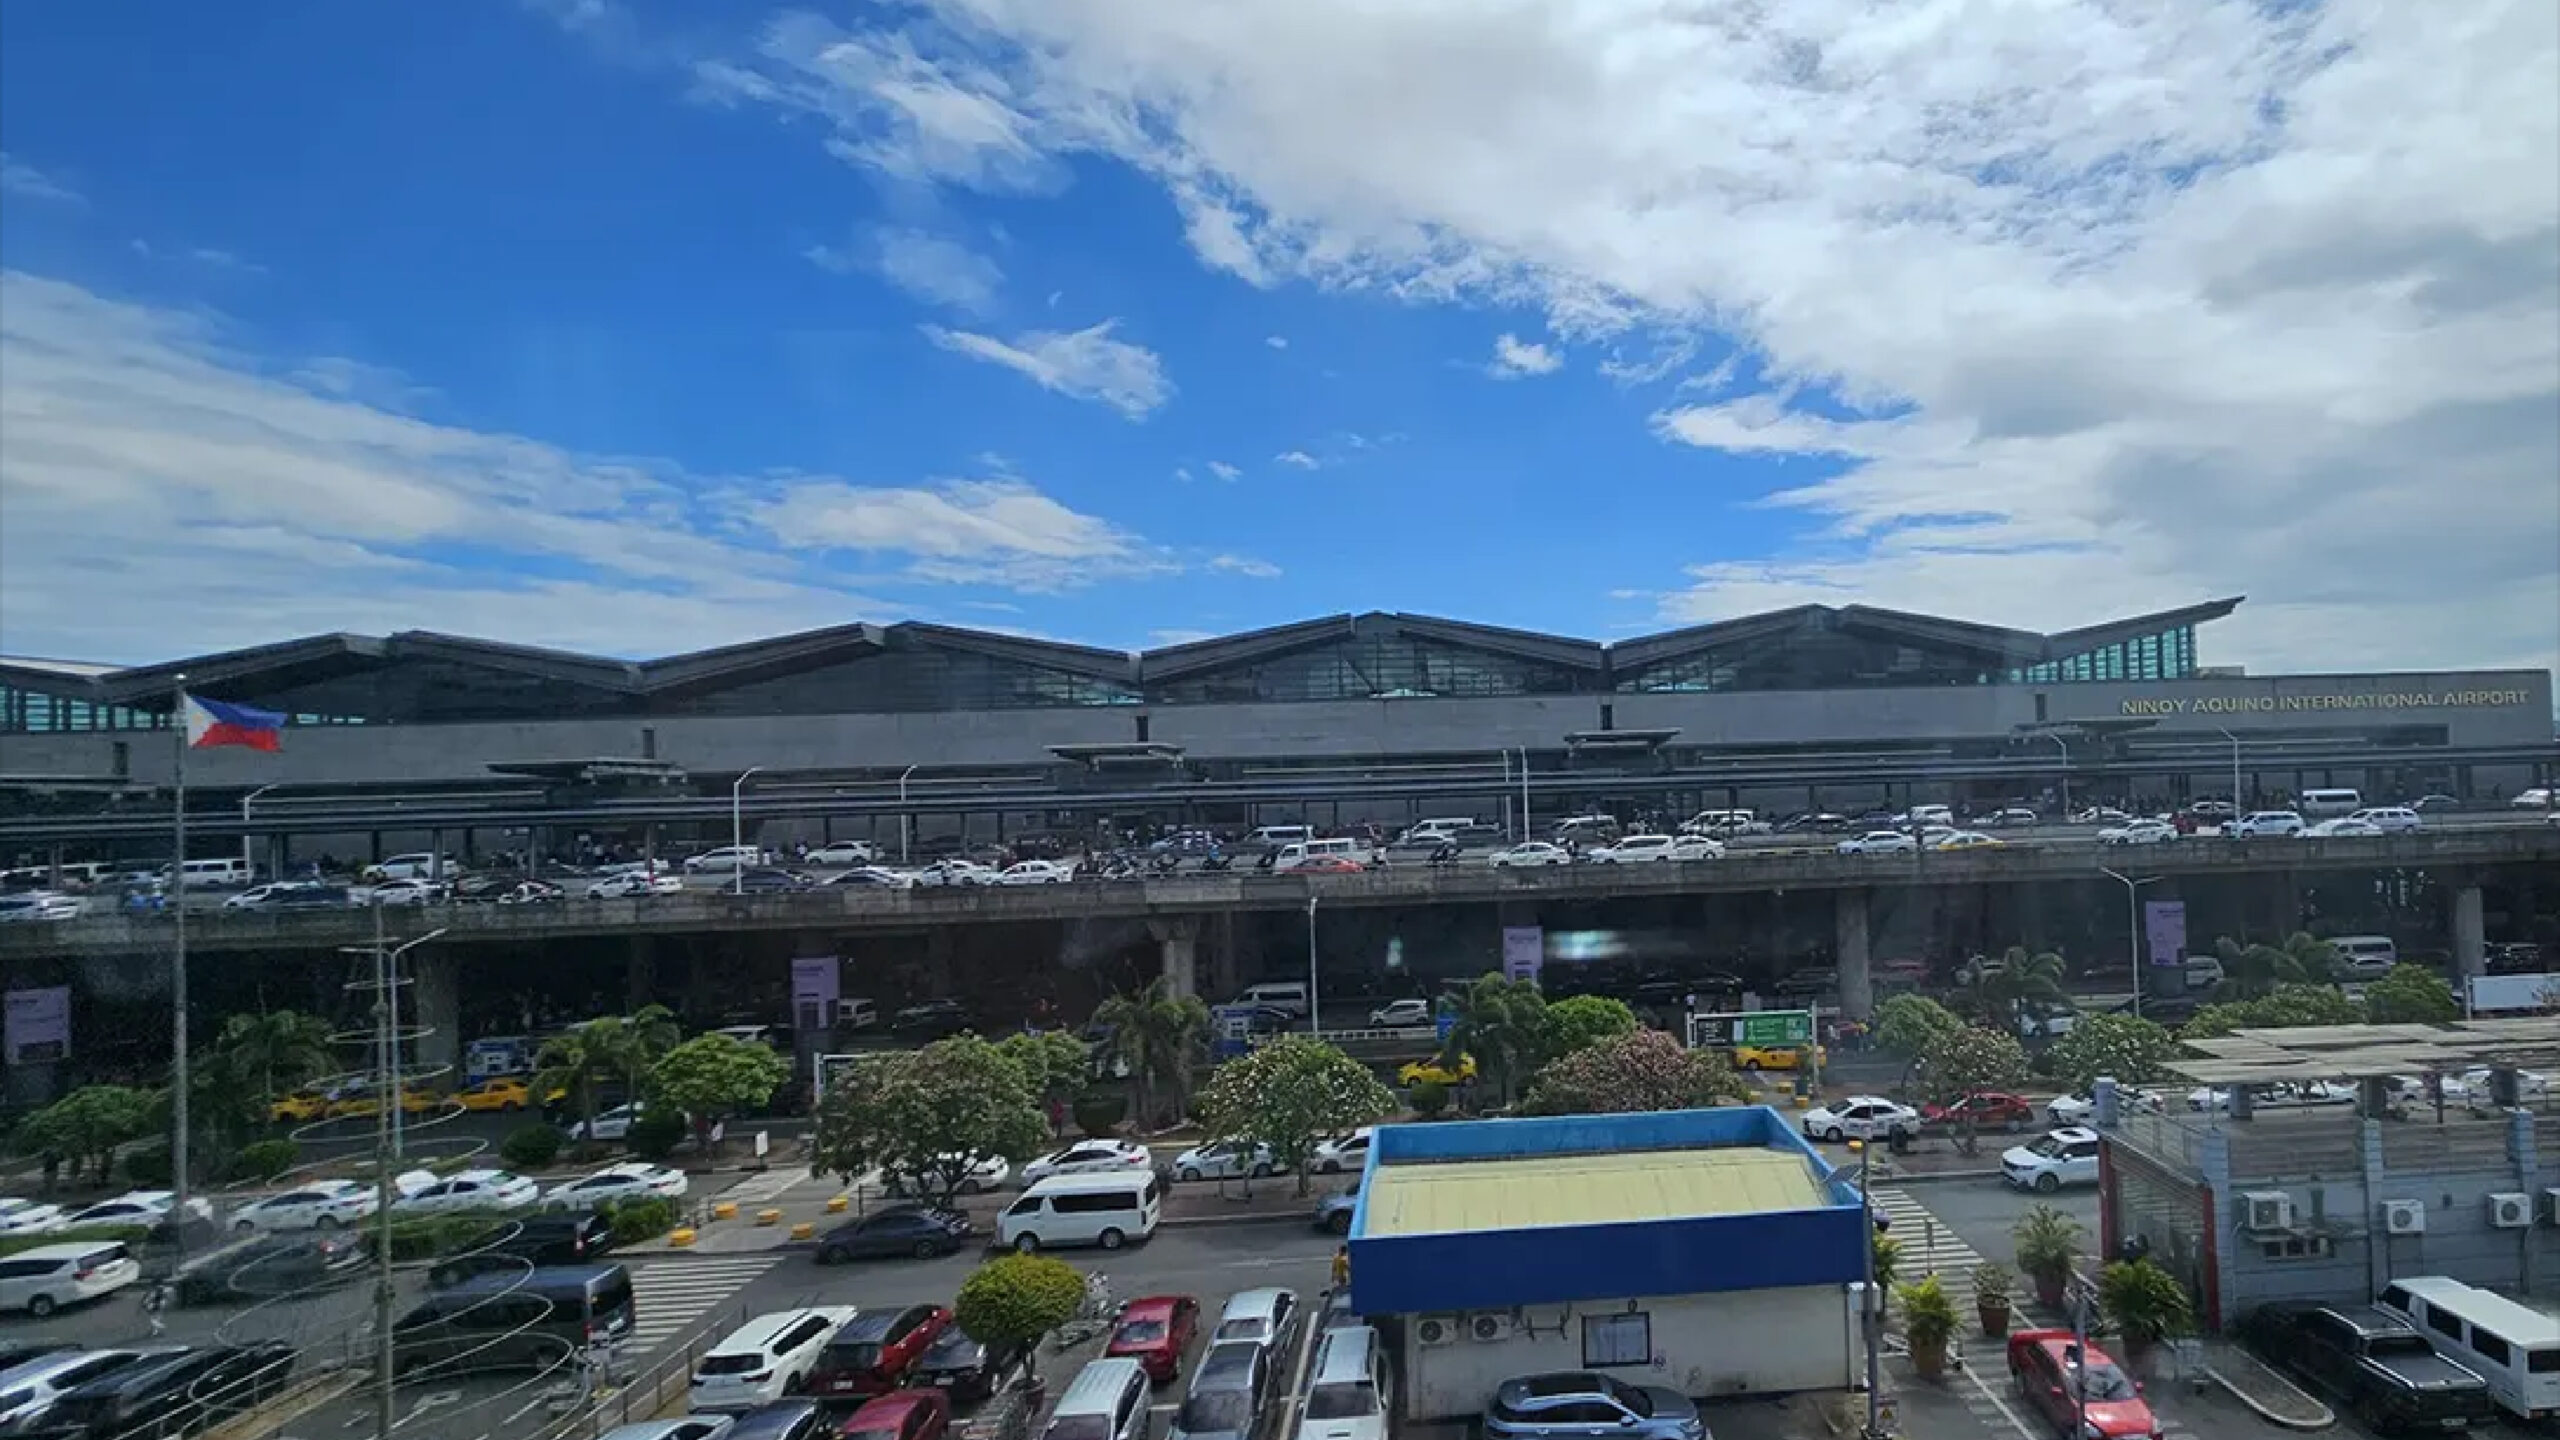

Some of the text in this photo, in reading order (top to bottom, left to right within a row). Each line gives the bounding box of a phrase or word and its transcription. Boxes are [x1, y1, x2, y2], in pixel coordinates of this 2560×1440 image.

[2121, 690, 2529, 713] NINOY AQUINO INTERNATIONAL AIRPORT
